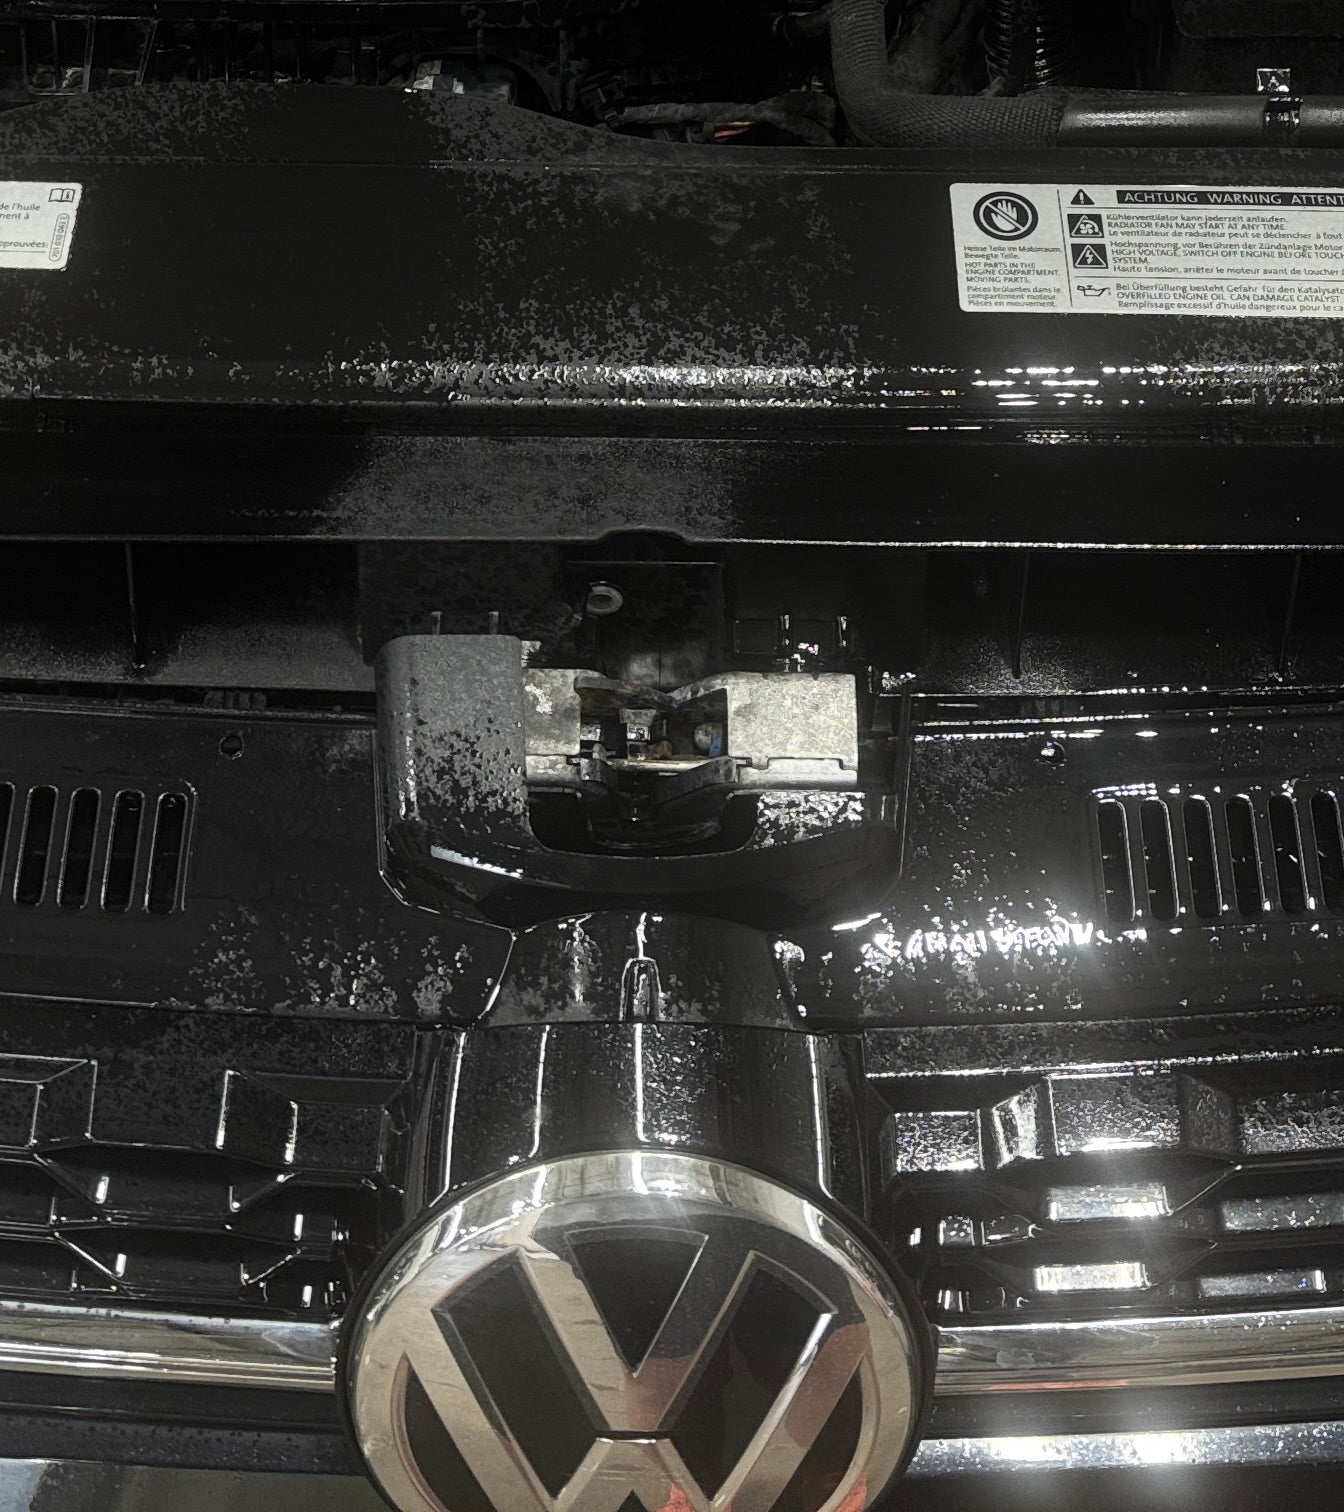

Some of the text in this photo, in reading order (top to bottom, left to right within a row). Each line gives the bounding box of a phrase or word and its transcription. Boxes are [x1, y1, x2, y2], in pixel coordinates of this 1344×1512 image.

[1124, 192, 1199, 203] ACHTUNG
[1207, 193, 1282, 204] WARNING
[12, 203, 41, 211] l'huile
[24, 212, 30, 220] à
[1106, 214, 1178, 222] Kühlerventilator
[1180, 214, 1202, 222] kann
[1205, 215, 1244, 223] jederzeit
[1258, 243, 1312, 252] Zündanlage
[1183, 249, 1218, 257] SWITCH
[1189, 284, 1224, 292] besteht
[1226, 284, 1257, 292] Gefahr
[1263, 285, 1276, 293] für
[967, 293, 1025, 301] compartiment
[1253, 294, 1294, 302] DAMAGE
[1118, 301, 1175, 310] Remplissage
[1248, 303, 1297, 312] dangereux
[1300, 305, 1320, 313] pour
